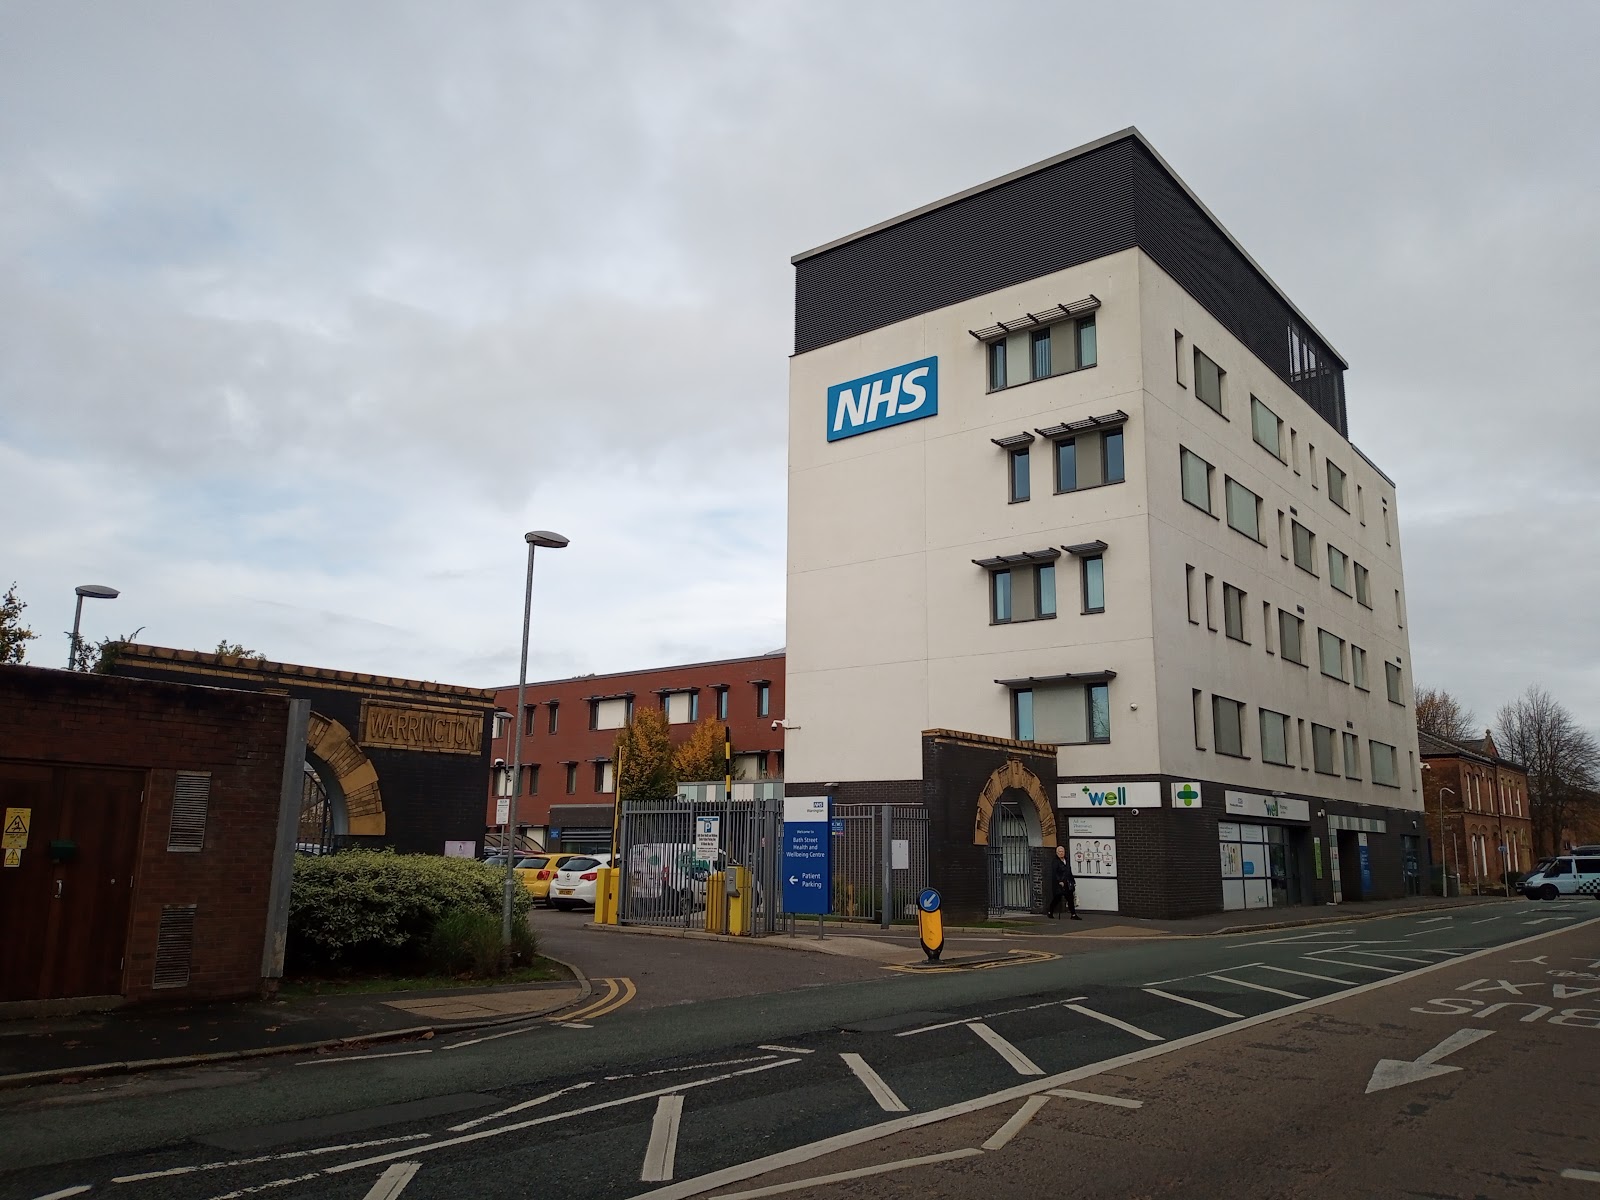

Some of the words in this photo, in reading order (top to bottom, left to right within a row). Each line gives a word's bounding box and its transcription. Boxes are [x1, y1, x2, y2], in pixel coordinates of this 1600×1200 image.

[833, 367, 929, 432] NHS
[1088, 787, 1126, 806] well
[802, 881, 822, 889] Parking
[1455, 978, 1600, 999] AXI
[1410, 998, 1600, 1029] BUS
